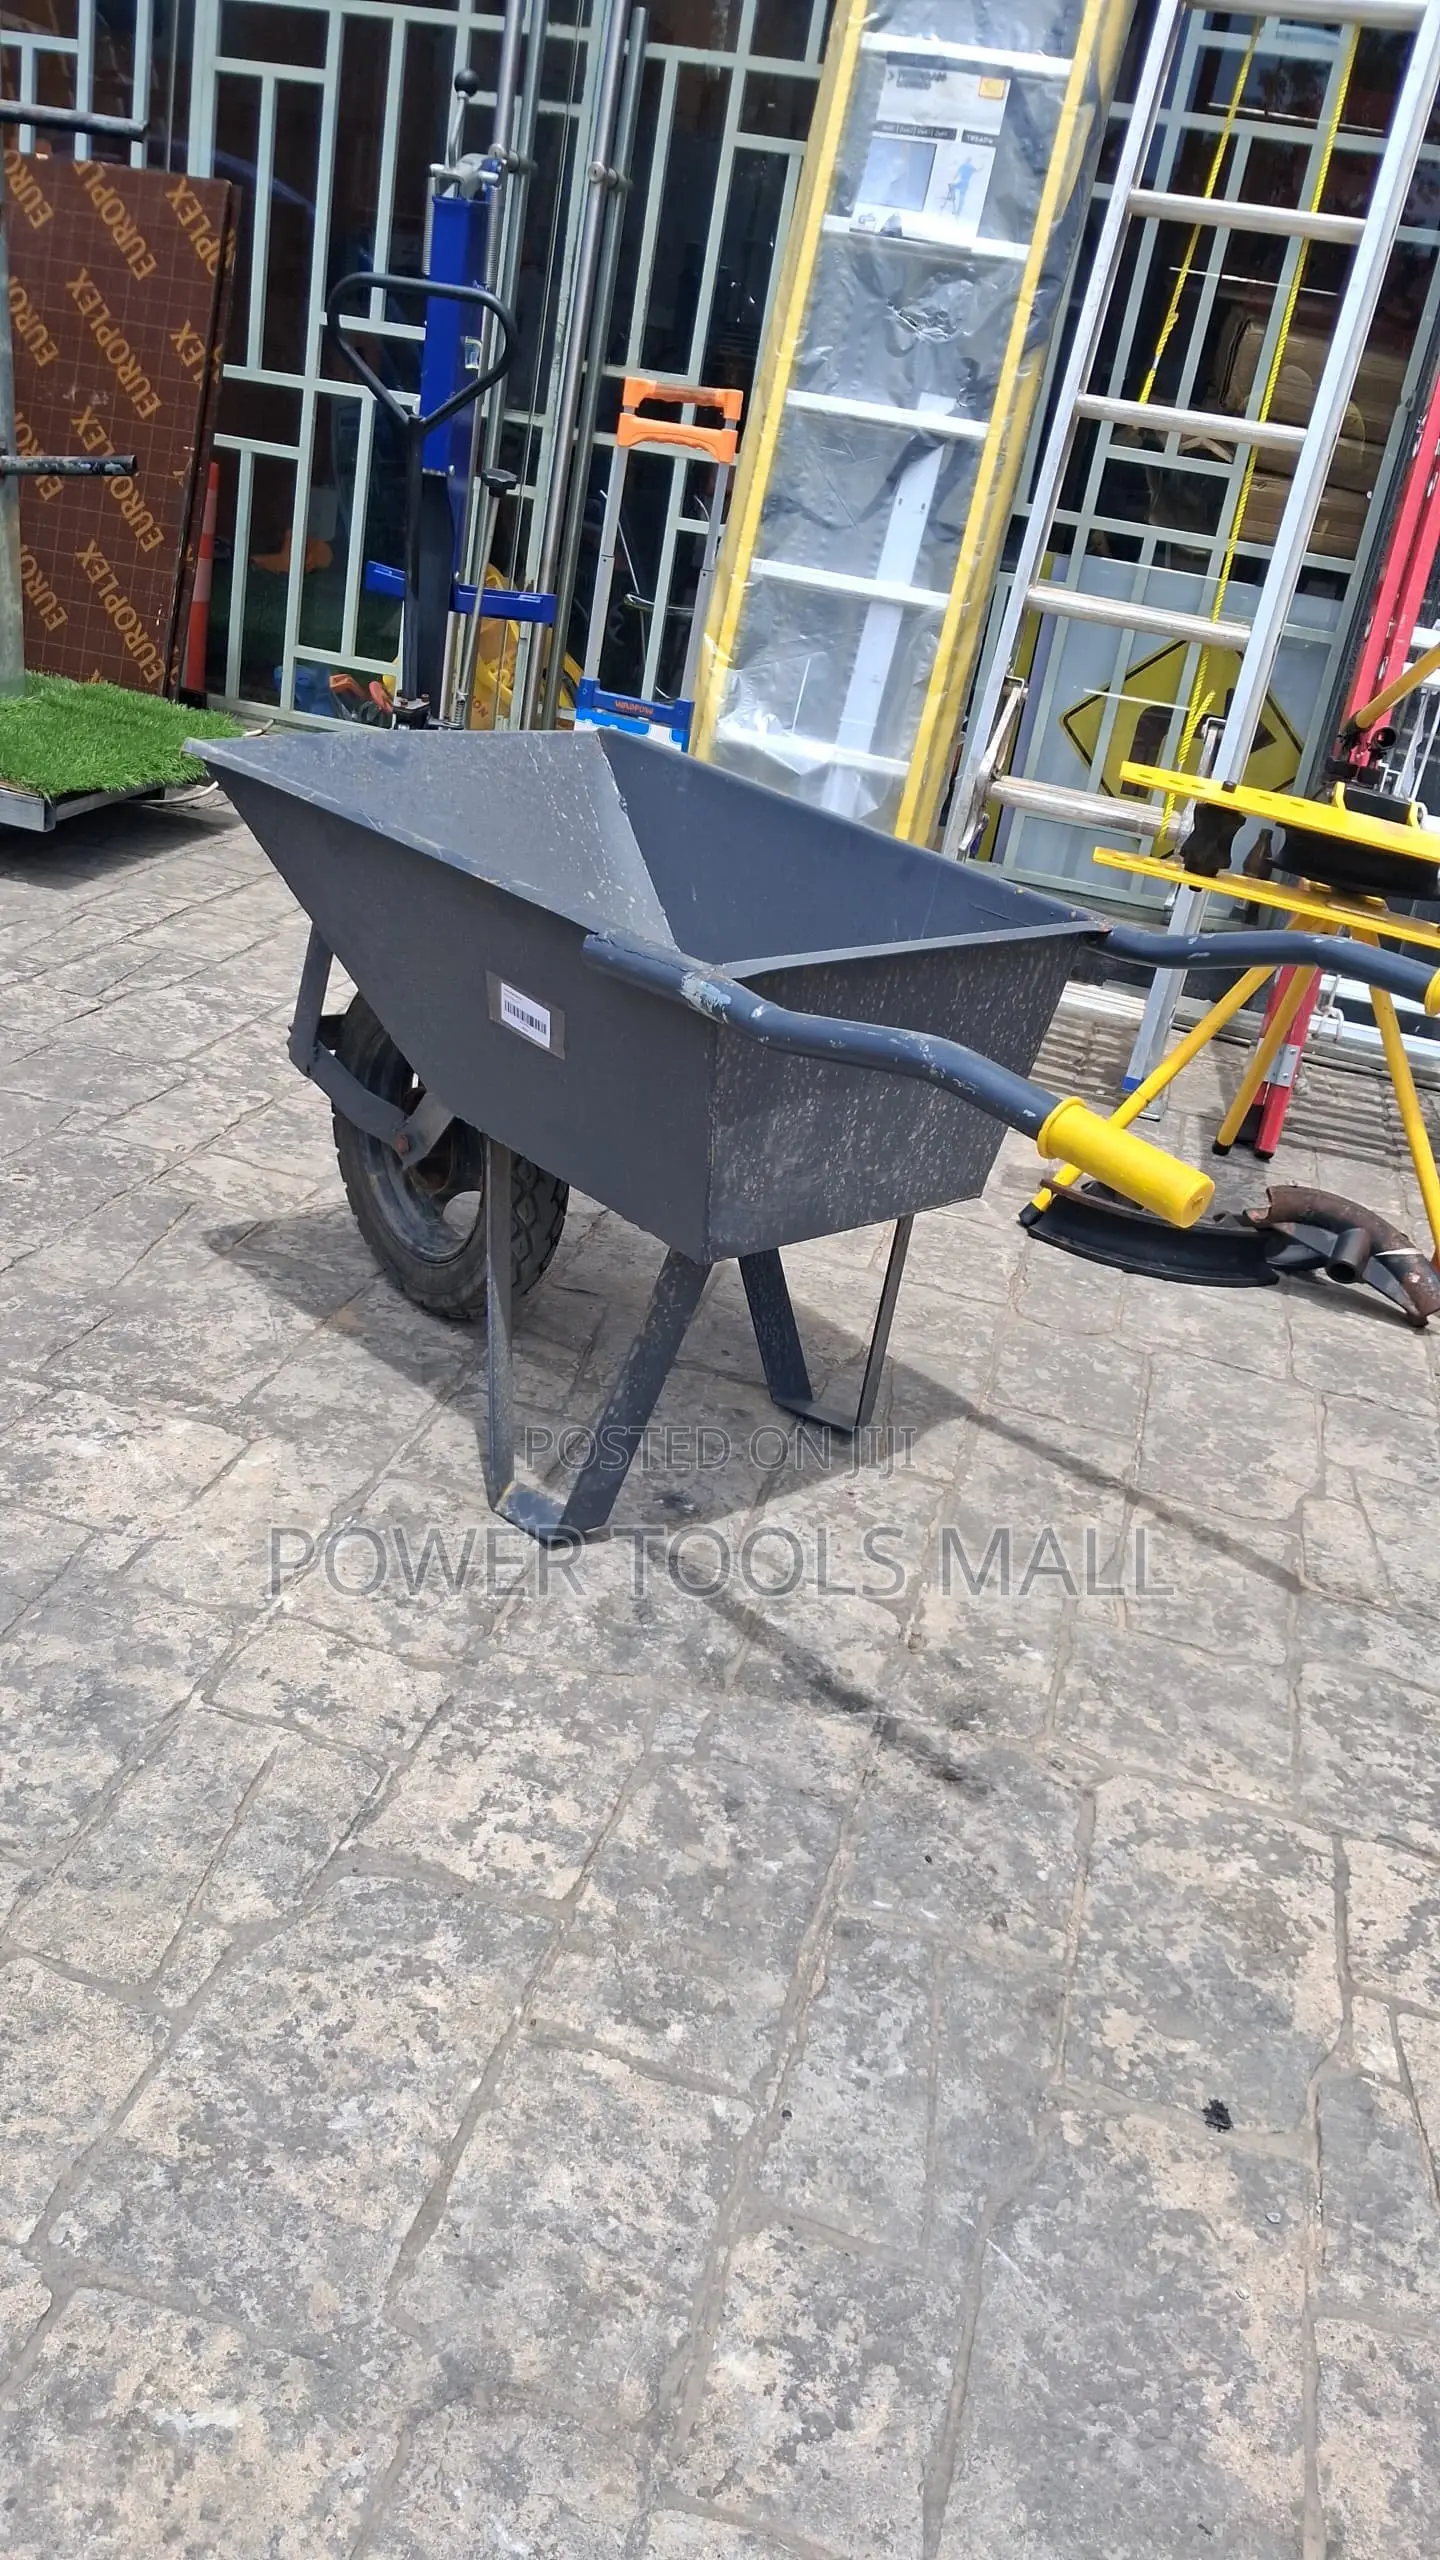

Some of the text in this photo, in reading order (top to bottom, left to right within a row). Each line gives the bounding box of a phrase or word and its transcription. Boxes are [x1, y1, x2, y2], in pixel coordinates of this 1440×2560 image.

[66, 267, 163, 419] EUROPLEX
[71, 405, 165, 552] EUROLEX
[75, 539, 167, 683] EUROPLEX
